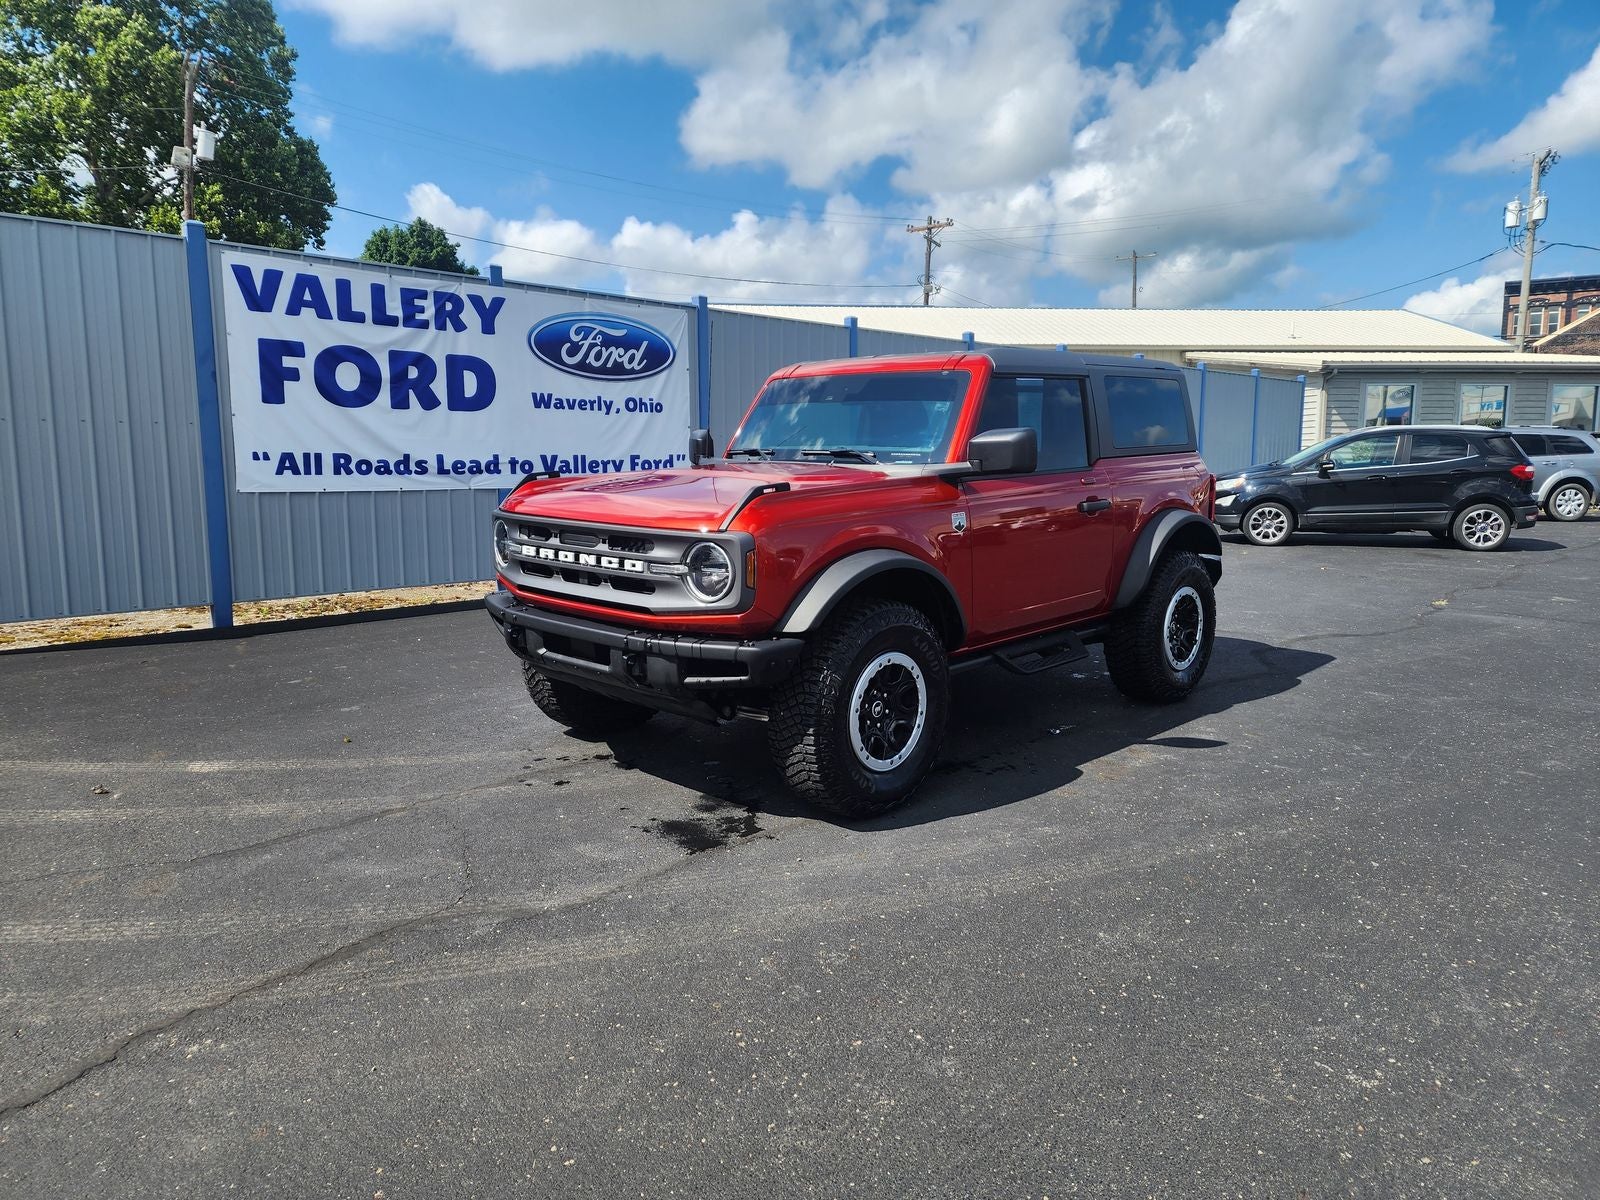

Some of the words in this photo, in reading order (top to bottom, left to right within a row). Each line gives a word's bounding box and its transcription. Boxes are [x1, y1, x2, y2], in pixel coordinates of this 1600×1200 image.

[231, 263, 506, 336] VALLERY
[560, 322, 649, 371] Ford
[257, 337, 497, 412] FORD
[531, 392, 620, 416] Waverly,
[624, 397, 664, 414] Ohio
[332, 453, 429, 476] Roads
[435, 453, 502, 476] Lead
[507, 456, 537, 478] to
[521, 545, 644, 572] BRONCO
